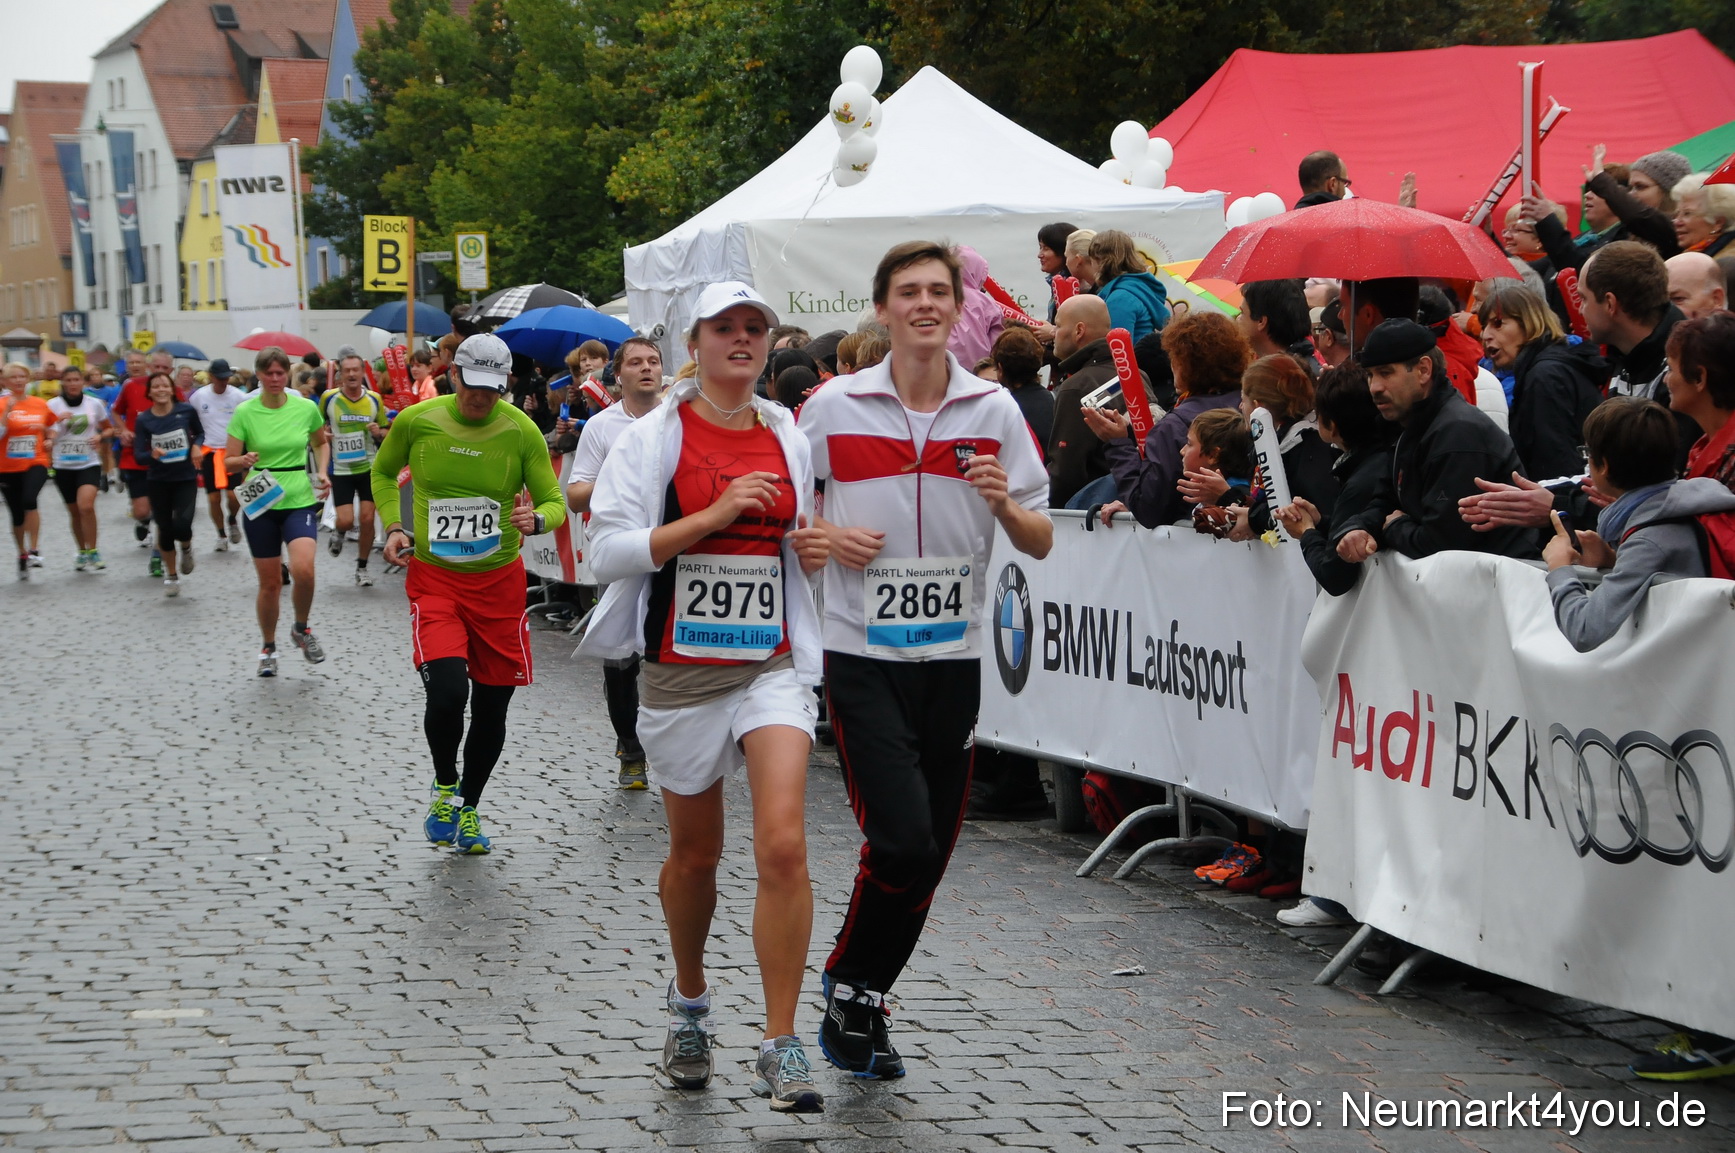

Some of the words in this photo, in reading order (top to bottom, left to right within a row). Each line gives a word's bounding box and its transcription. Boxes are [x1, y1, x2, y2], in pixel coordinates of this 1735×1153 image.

[370, 218, 408, 233] Block
[377, 239, 401, 274] B
[787, 290, 870, 314] Kinder
[473, 358, 505, 370] saller
[1124, 396, 1146, 432] BKK
[337, 438, 363, 451] 3103
[449, 446, 483, 457] saller
[454, 504, 488, 512] Neumarkt
[436, 513, 494, 540] 2719
[678, 563, 716, 575] PARTL
[718, 565, 768, 576] Neumarkt
[866, 568, 903, 578] PARTL
[905, 567, 956, 578] Neumarkt
[686, 578, 775, 620] 2979
[876, 581, 963, 620] 2864
[678, 626, 779, 646] Tamara-Lilian
[906, 629, 933, 644] Luis
[1043, 600, 1119, 682] BMW
[1126, 610, 1249, 721] Laufsport
[1332, 672, 1436, 789] Audi
[1452, 701, 1557, 830] BKK
